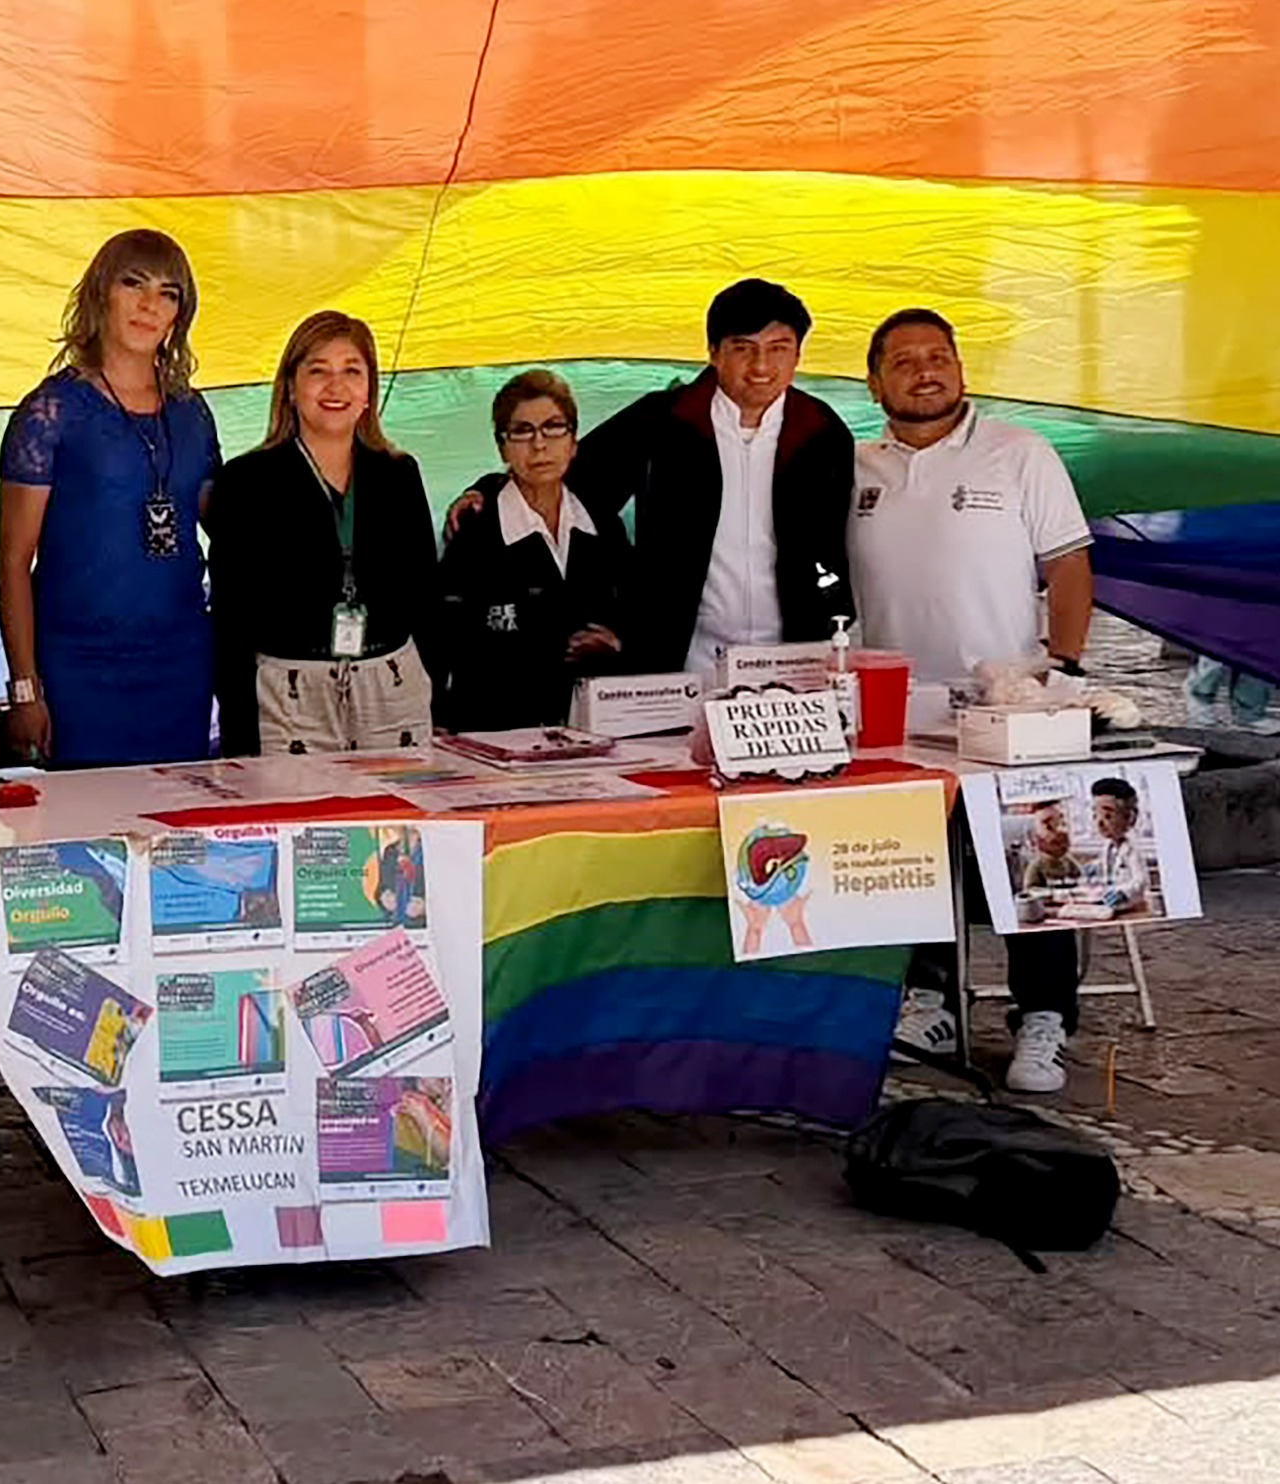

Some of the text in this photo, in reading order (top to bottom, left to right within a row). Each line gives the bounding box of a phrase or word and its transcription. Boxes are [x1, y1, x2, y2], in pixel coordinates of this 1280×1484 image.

[726, 699, 825, 721] PRUEBAS
[733, 717, 828, 739] RAPIDAS
[747, 740, 776, 757] DE
[851, 843, 869, 853] de
[870, 838, 901, 855] julio
[3, 880, 84, 901] Diversidad
[833, 867, 936, 896] Hepatitis
[177, 1098, 278, 1135] CESSA
[183, 1139, 223, 1158] SAN
[176, 1171, 296, 1197] TEXMELUCAN
